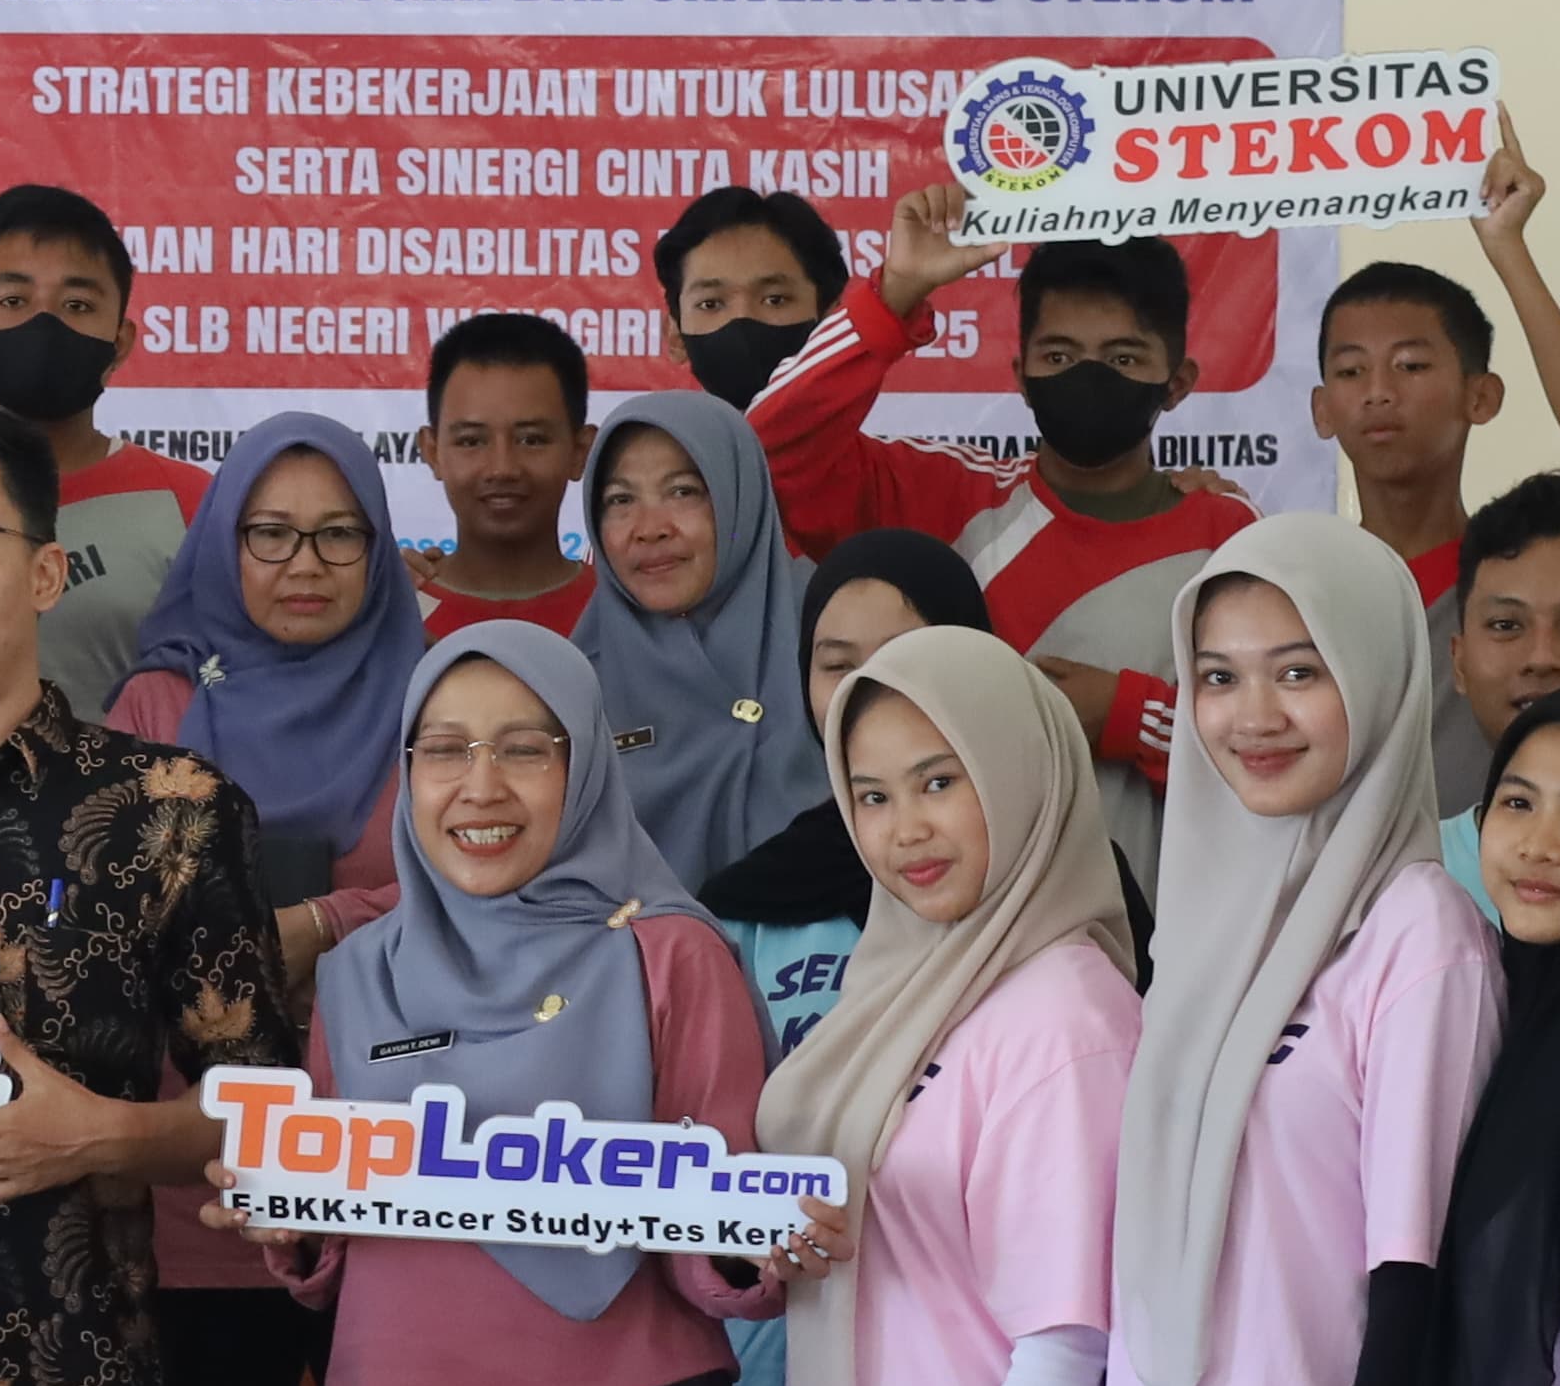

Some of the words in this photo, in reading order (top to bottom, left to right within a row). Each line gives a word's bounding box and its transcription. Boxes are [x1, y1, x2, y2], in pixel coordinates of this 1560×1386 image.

[32, 66, 249, 115] STRATEGI
[267, 68, 596, 117] KEBEKERJAAN
[614, 69, 766, 117] UNTUK
[1114, 59, 1490, 115] UNIVERSITAS
[969, 111, 987, 170] UNIVERSITAS
[983, 89, 1011, 111] SAINS
[1021, 85, 1073, 114] TEKNOLOGI
[1059, 111, 1079, 165] KOMPUTER
[1114, 108, 1488, 183] STEKOM
[235, 147, 380, 195] SERTA
[397, 148, 577, 196] SINERGI
[597, 149, 731, 196] CINTA
[750, 149, 888, 197] KASIH
[984, 169, 1061, 190] STEKOM
[961, 204, 1156, 239] Kuliahnya
[1168, 186, 1469, 229] Menyenangkan
[232, 227, 339, 274] HARI
[358, 227, 640, 277] DISABILITAS
[143, 306, 229, 353] SLB
[247, 307, 409, 354] NEGERI
[217, 1081, 831, 1198] TopLoker.com
